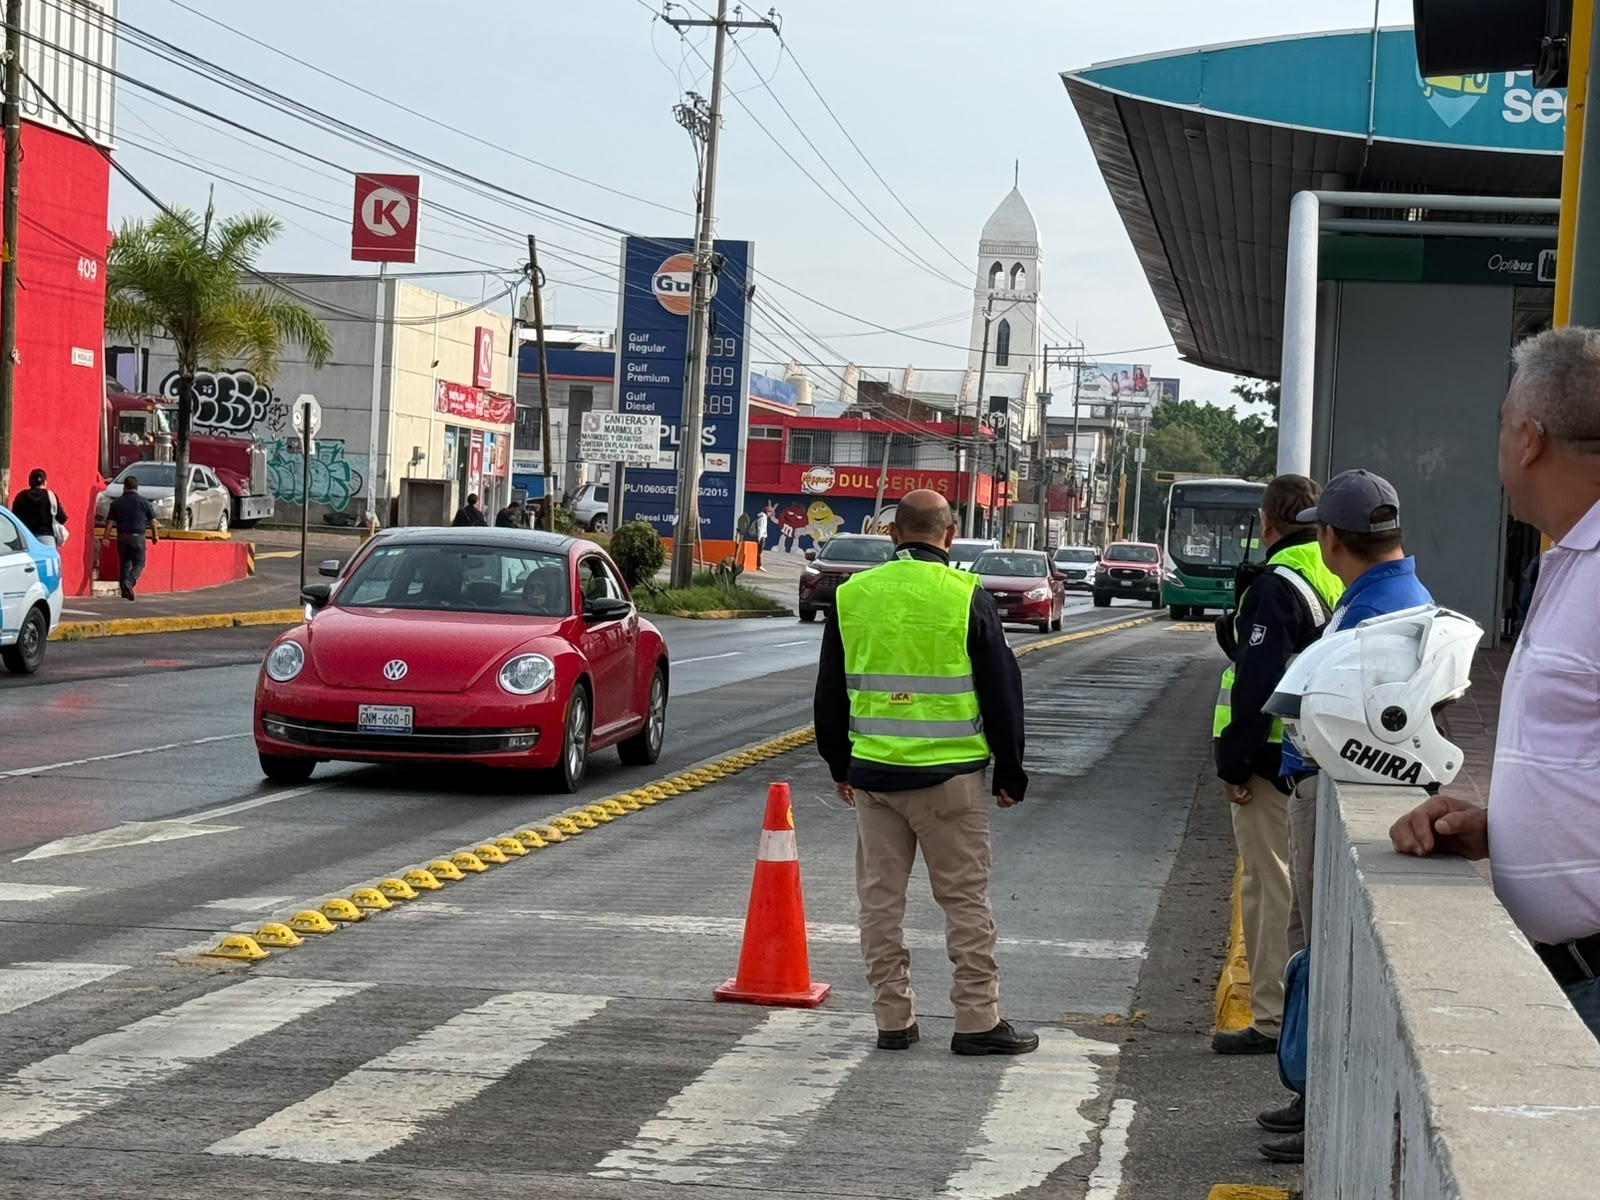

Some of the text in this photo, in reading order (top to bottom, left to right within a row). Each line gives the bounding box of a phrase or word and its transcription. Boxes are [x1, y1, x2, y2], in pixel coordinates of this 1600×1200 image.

[1501, 88, 1567, 126] se
[77, 256, 97, 279] 409
[1488, 254, 1533, 272] Optibus
[629, 333, 649, 343] Gulf
[628, 343, 666, 354] Regular
[627, 363, 648, 373] Gulf
[627, 373, 670, 383] Premium
[626, 392, 647, 401] Gulf
[625, 402, 655, 412] Diesel
[604, 414, 648, 425] CANTERAS
[649, 417, 656, 426] Y
[603, 425, 643, 435] MARMOLES
[660, 424, 717, 446] PLS
[839, 473, 949, 492] DULCERÍAS
[635, 512, 660, 522] Diesel
[781, 524, 793, 537] m
[360, 712, 411, 727] GNM-660-D
[1339, 738, 1422, 784] GHIRA
